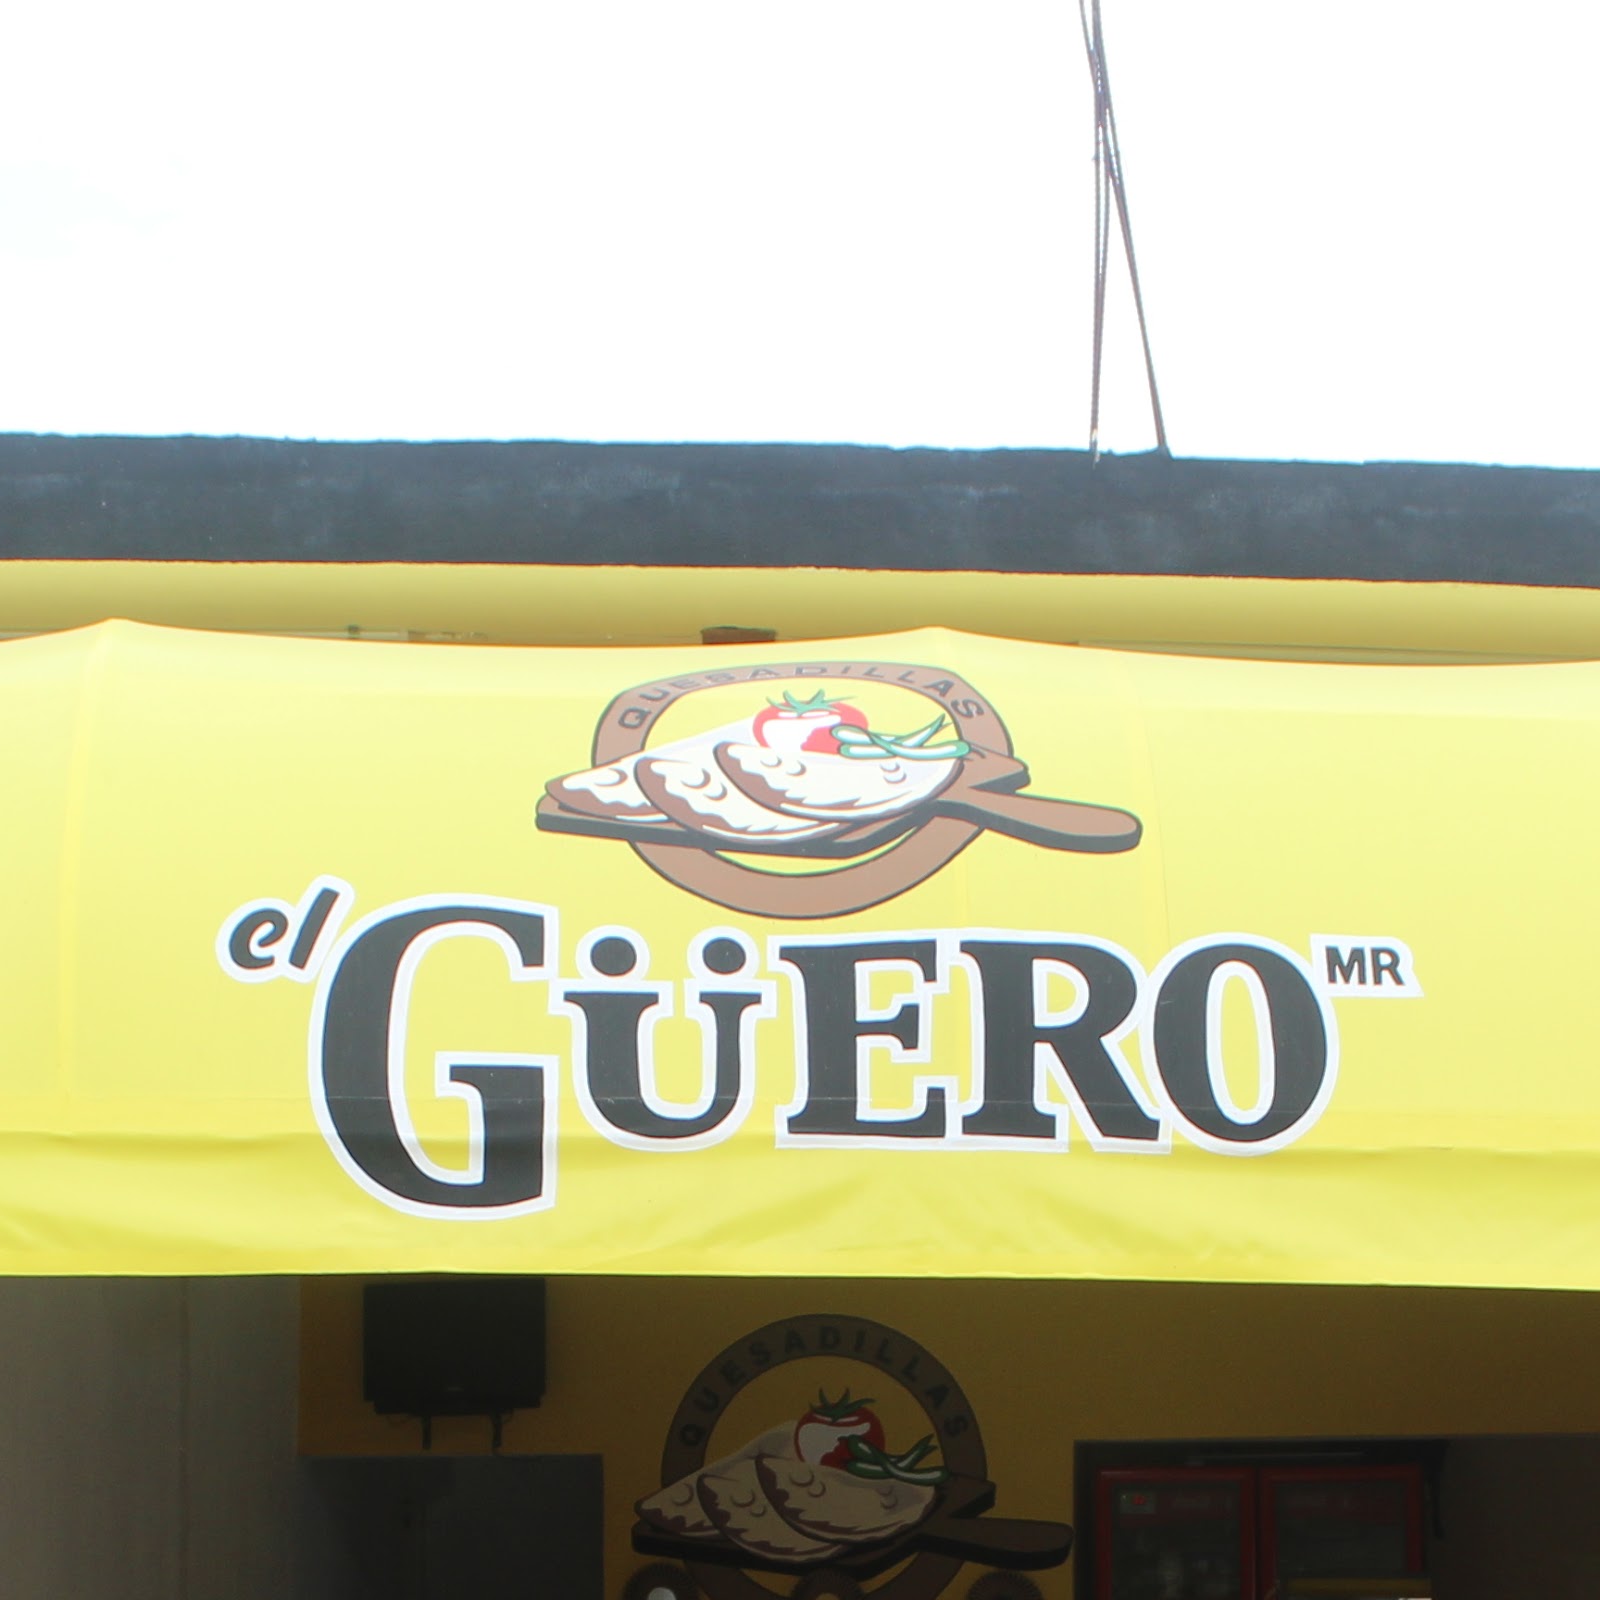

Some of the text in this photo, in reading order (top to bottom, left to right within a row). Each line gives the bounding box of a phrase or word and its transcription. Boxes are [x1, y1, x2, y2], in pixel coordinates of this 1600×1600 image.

[616, 662, 985, 730] QUESADILLAS
[226, 886, 342, 974] el
[1323, 943, 1408, 988] MR
[678, 1324, 970, 1450] QUESADILLAS
